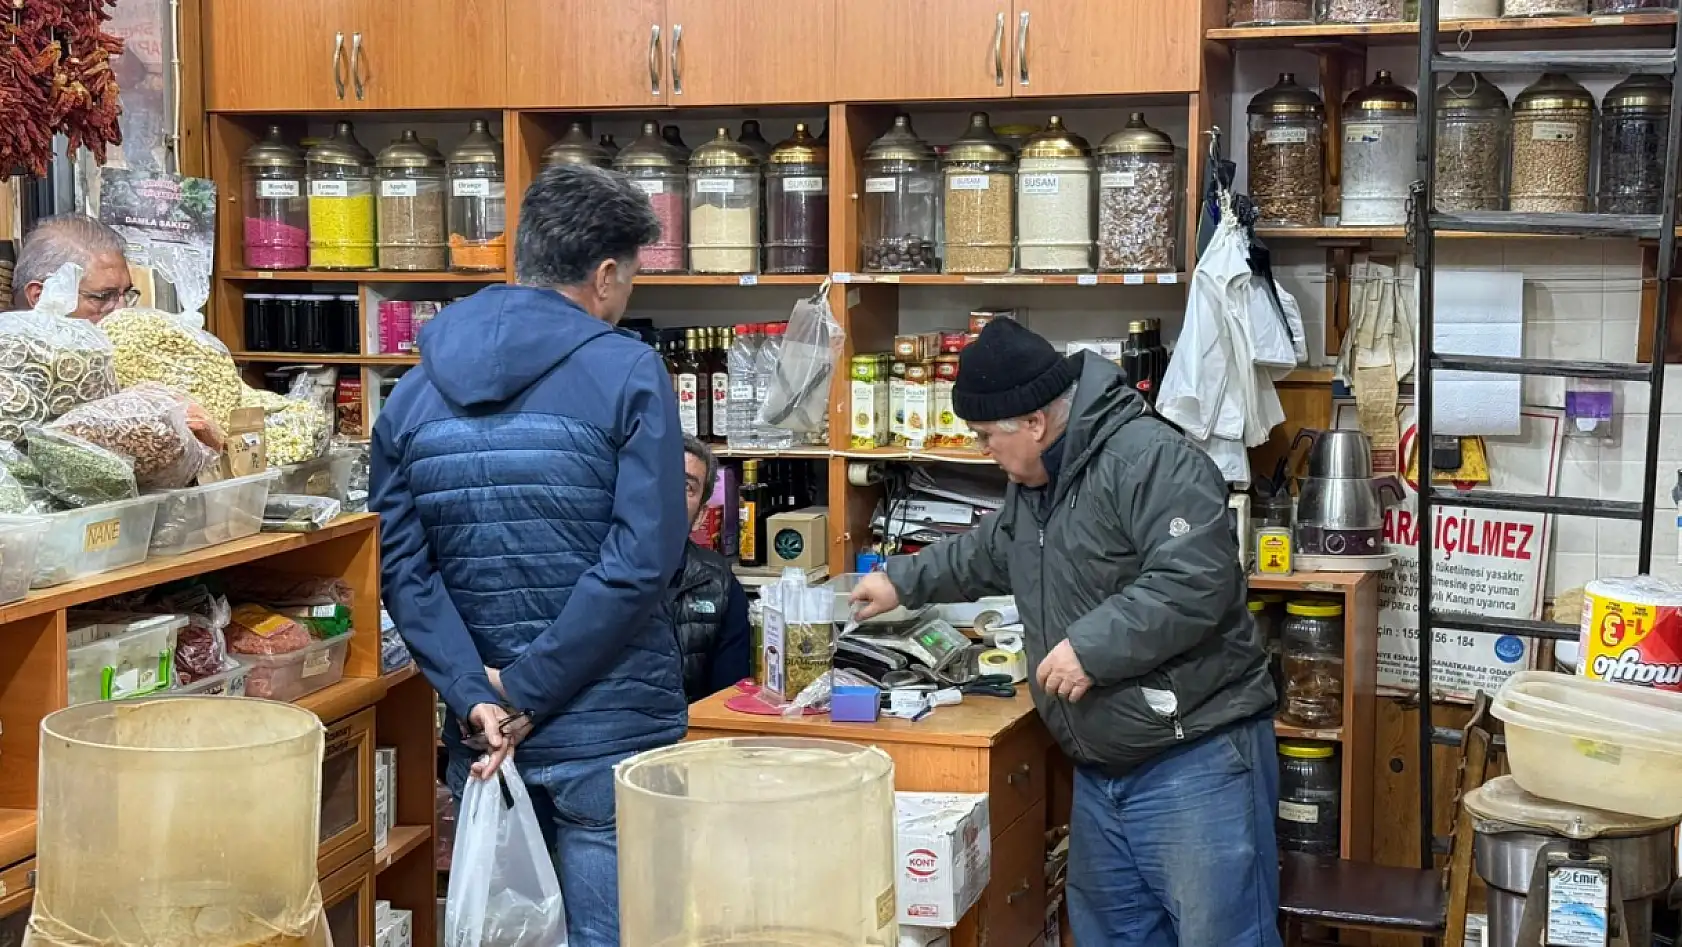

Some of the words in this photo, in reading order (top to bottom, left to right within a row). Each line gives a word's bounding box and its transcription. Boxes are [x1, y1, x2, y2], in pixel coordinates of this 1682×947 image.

[390, 183, 407, 191] Apple
[458, 182, 482, 190] Orange
[1024, 177, 1056, 187] SUSAM
[88, 520, 120, 546] NANE
[1382, 508, 1420, 546] ARA
[1434, 506, 1534, 560] İÇİLMEZ
[1436, 562, 1484, 578] tüketilmesi
[1486, 569, 1524, 583] yasaktır.
[1469, 581, 1486, 594] göz
[1488, 584, 1520, 597] yuman
[1445, 591, 1474, 605] Kanun
[1476, 596, 1516, 611] uyarınca
[1457, 635, 1474, 647] 184
[909, 858, 935, 867] KONT
